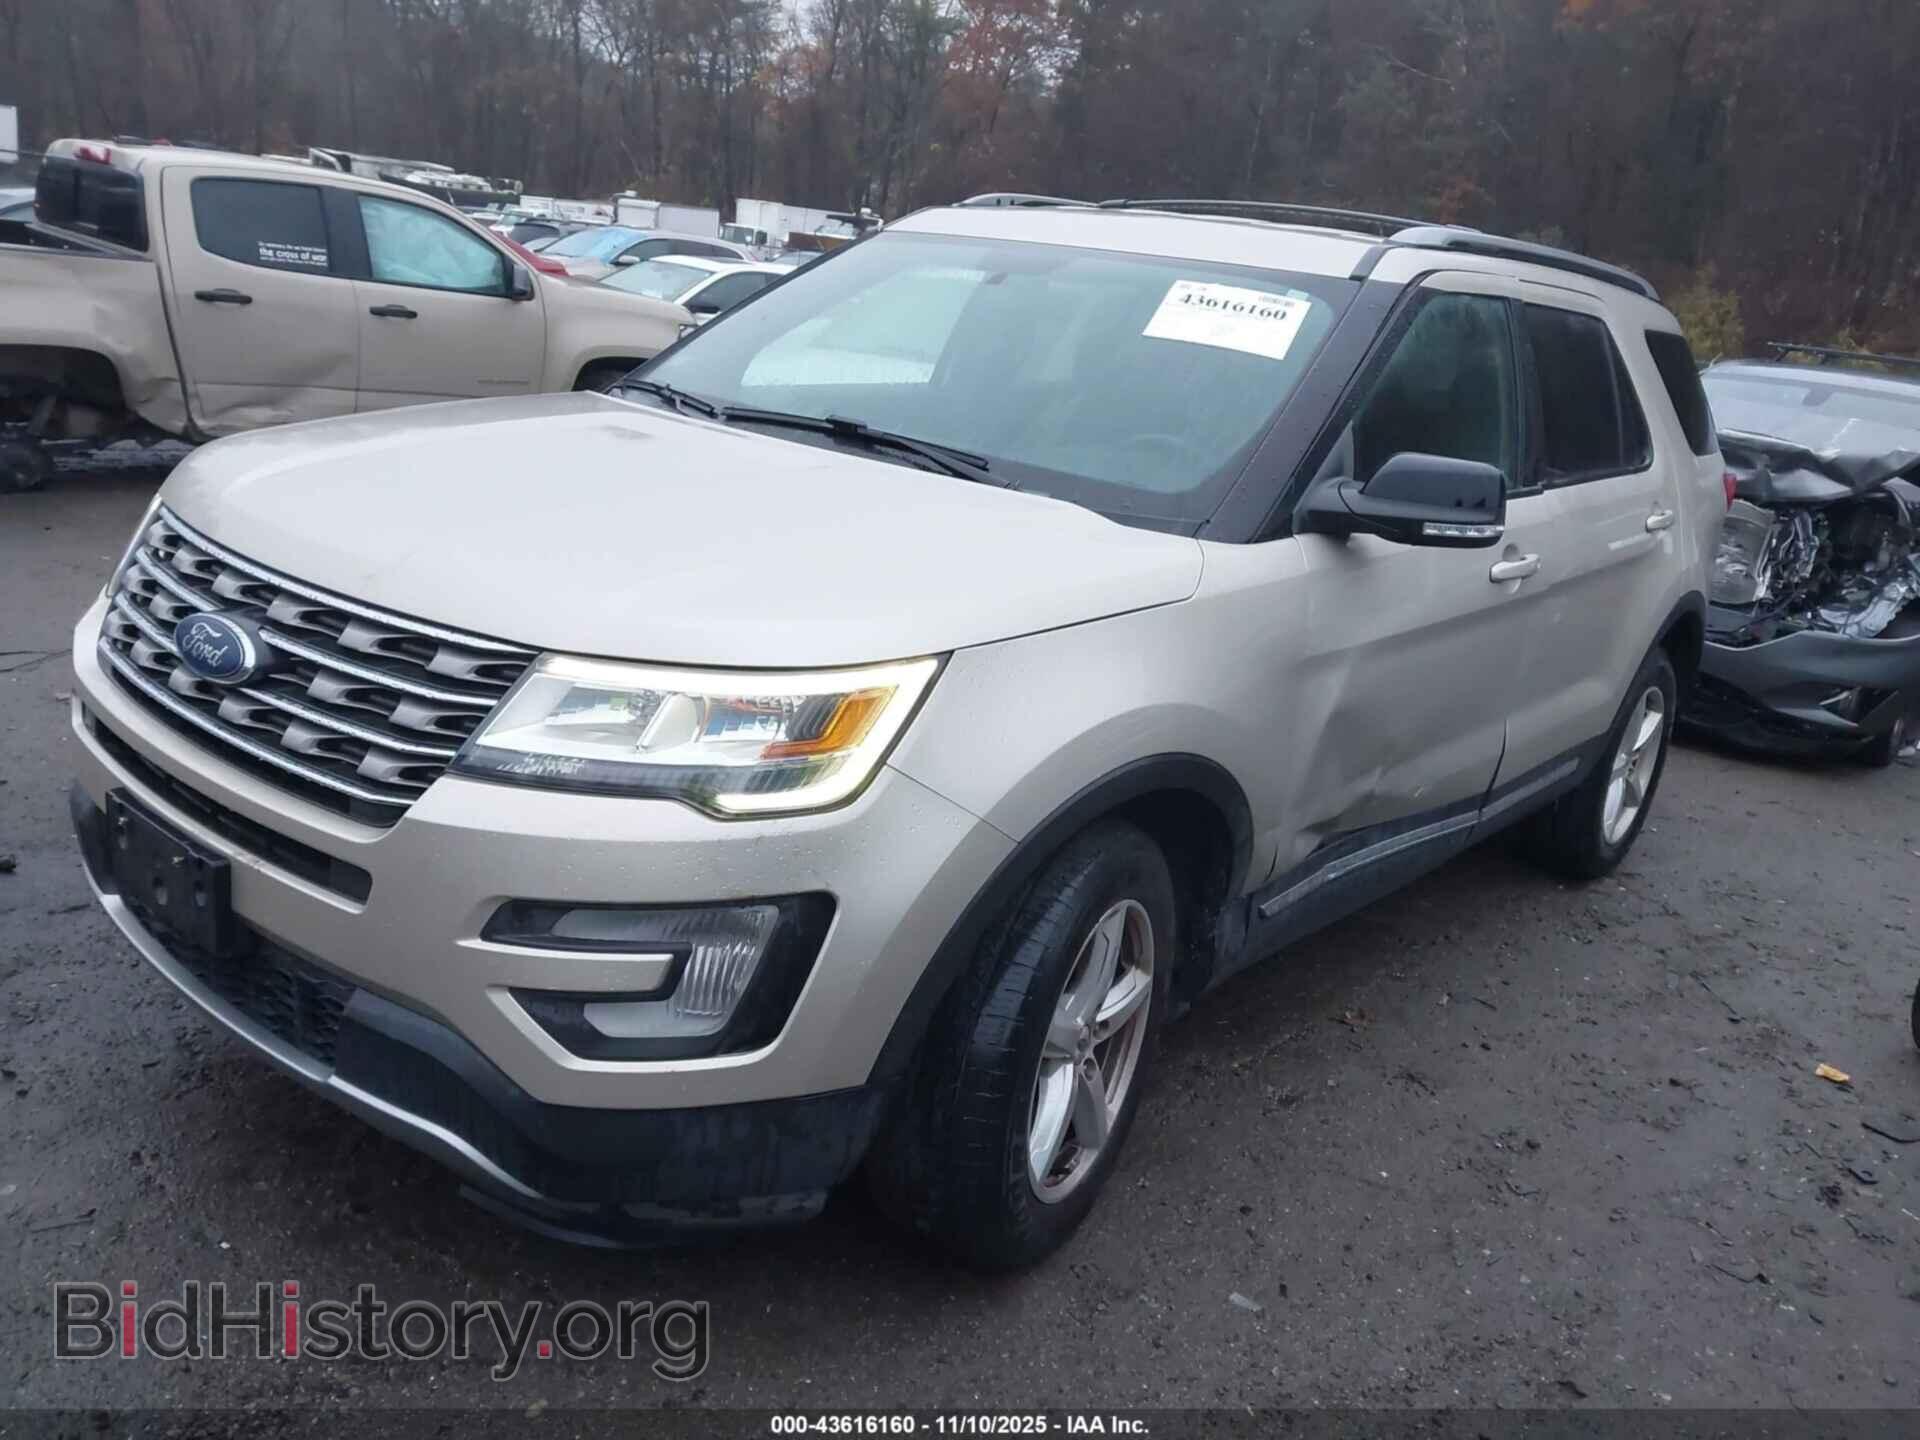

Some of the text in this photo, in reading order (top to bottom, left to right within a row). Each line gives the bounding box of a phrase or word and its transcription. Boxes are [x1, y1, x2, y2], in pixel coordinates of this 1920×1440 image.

[259, 247, 273, 257] the
[1180, 293, 1287, 320] 43616160
[182, 622, 228, 667] Ford
